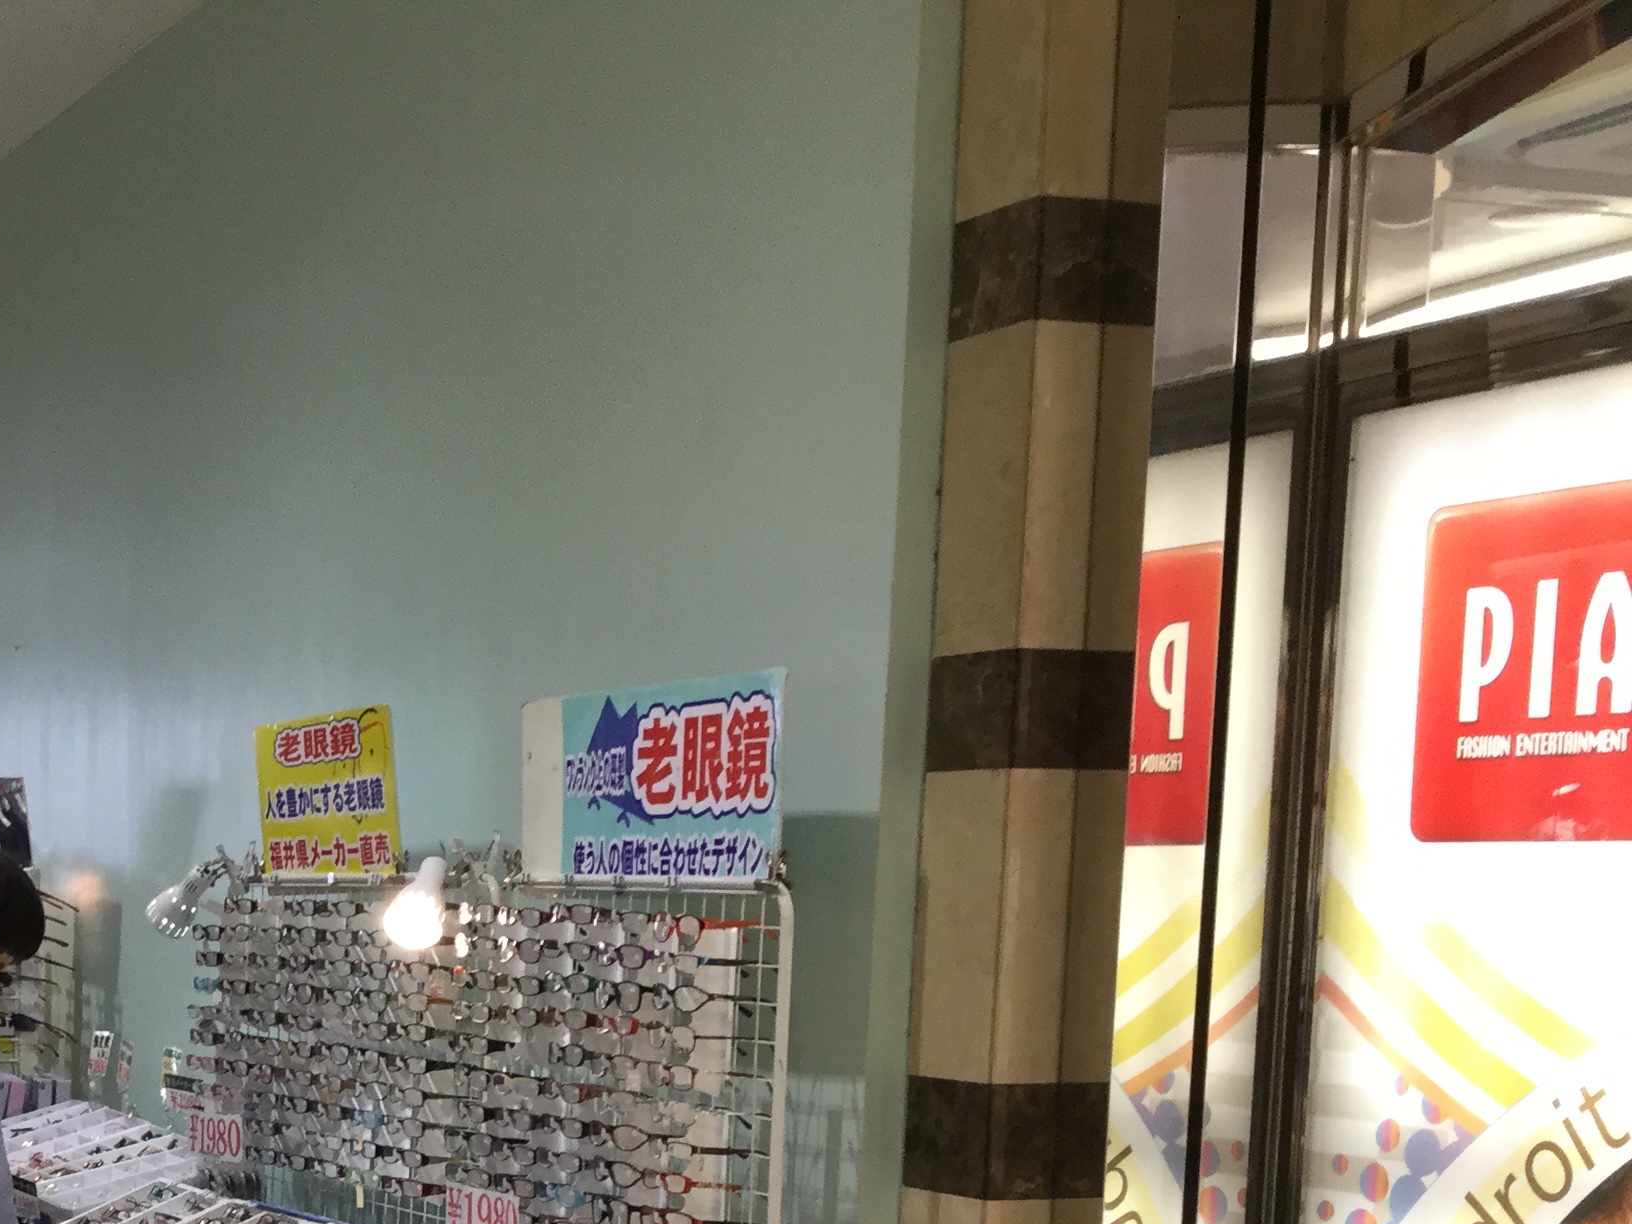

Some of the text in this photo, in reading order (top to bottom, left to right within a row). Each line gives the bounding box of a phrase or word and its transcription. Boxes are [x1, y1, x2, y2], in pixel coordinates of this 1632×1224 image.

[1459, 570, 1632, 724] PIA
[277, 720, 358, 763] 老眼鏡
[635, 705, 770, 806] 老眼鏡
[1456, 728, 1630, 761] FASHION ENTERTAINMENT
[265, 777, 385, 820] 人を豊かにする老眼鏡
[269, 832, 391, 871] 福井県メーカー直売
[573, 834, 764, 875] 使う人の個性に合わせたデザイン
[189, 1114, 241, 1158] ¥1980
